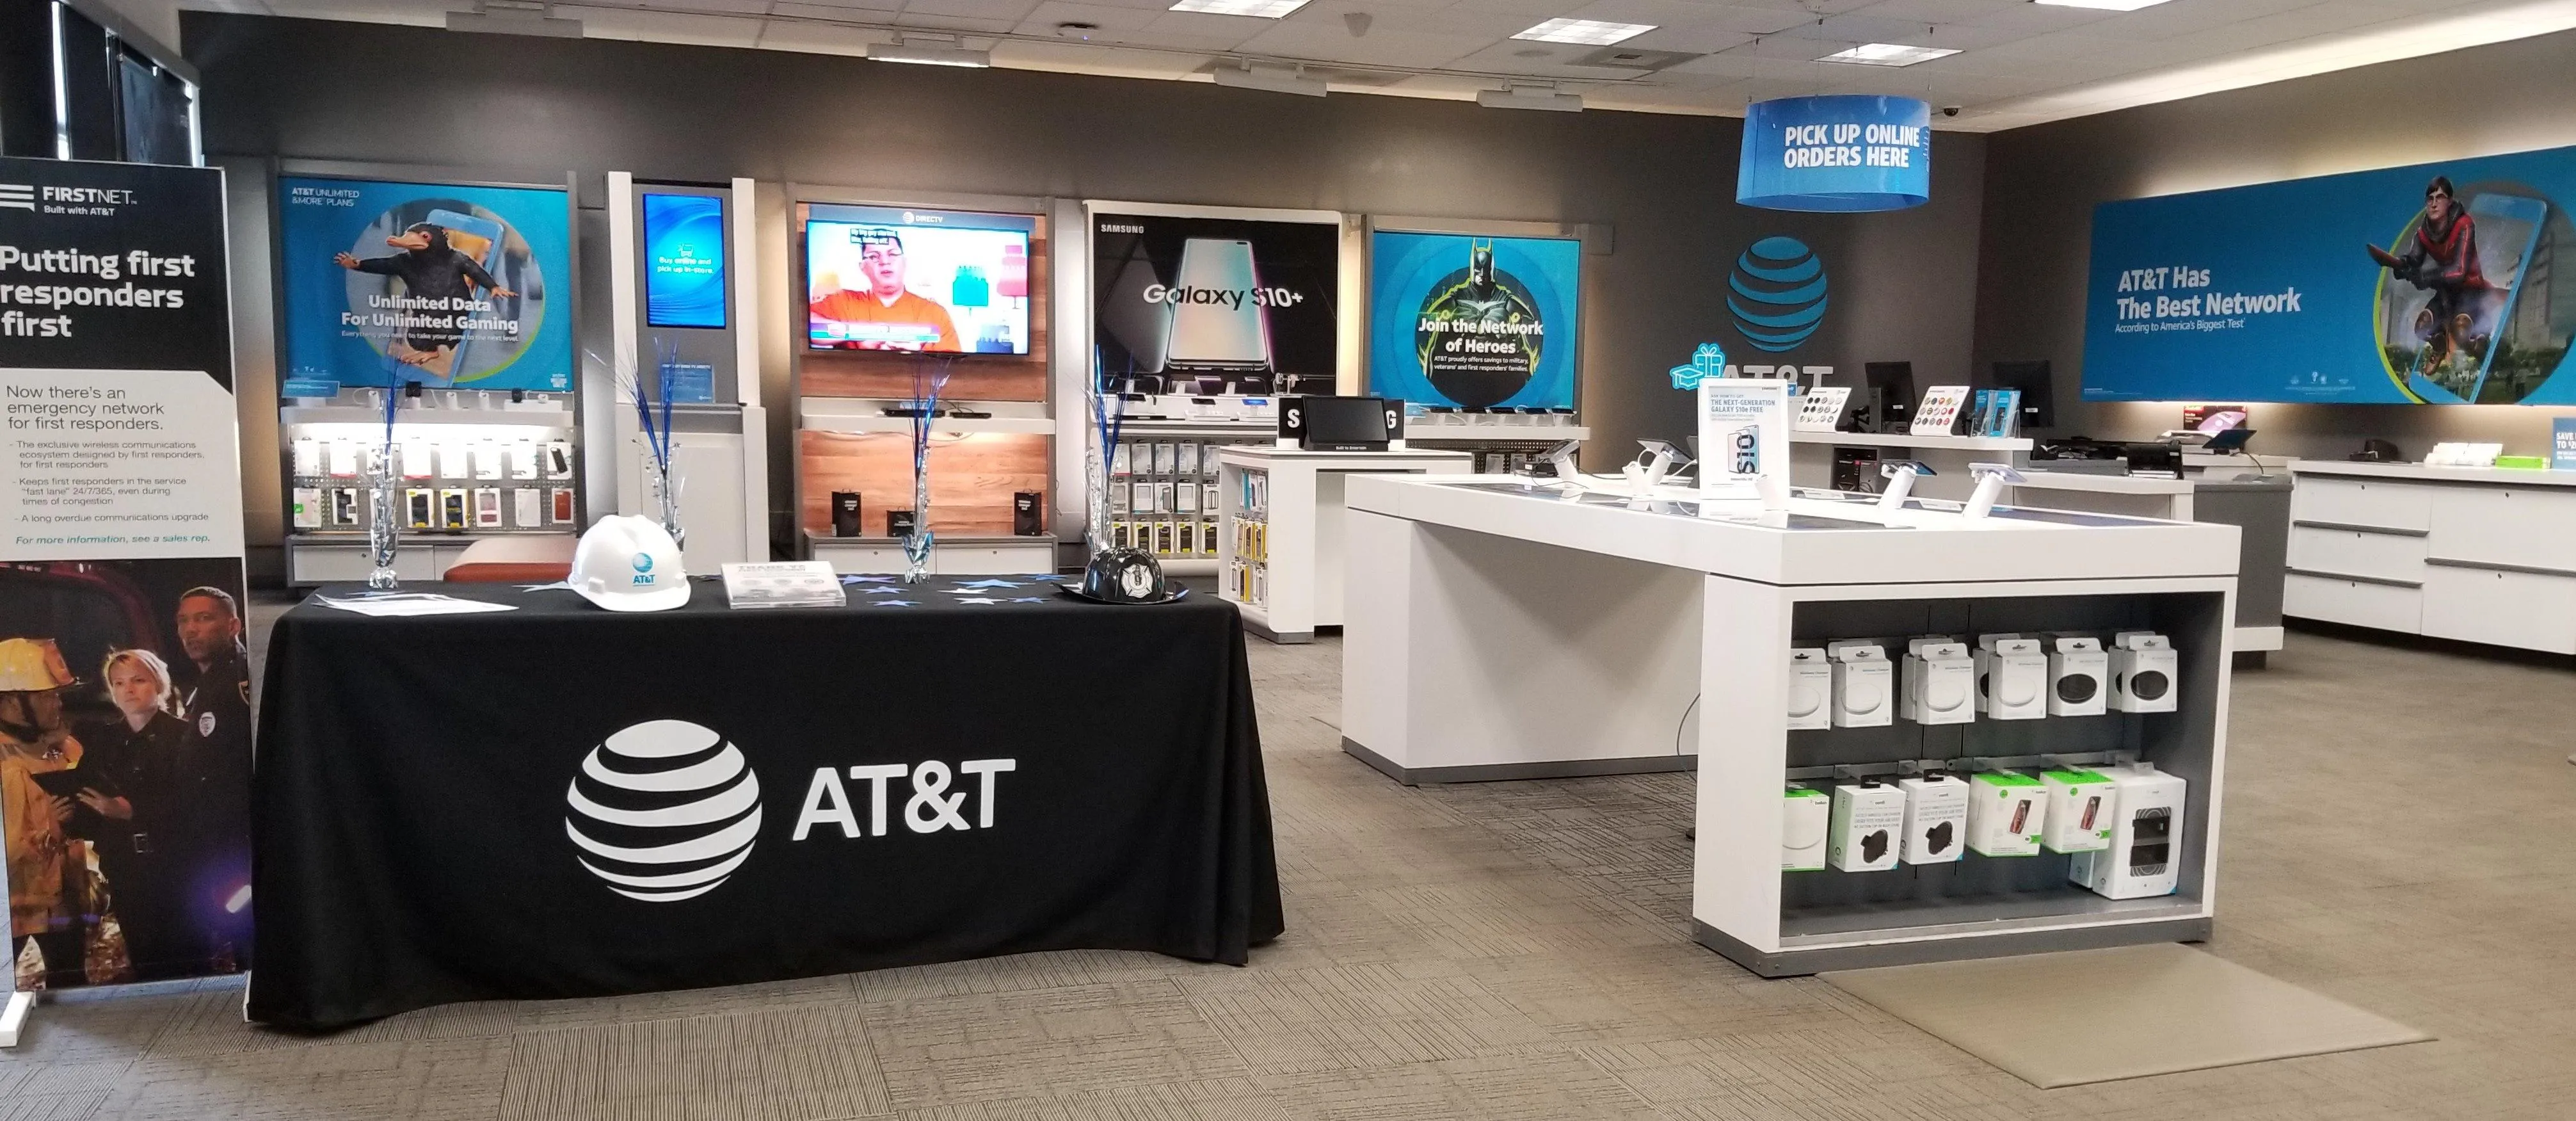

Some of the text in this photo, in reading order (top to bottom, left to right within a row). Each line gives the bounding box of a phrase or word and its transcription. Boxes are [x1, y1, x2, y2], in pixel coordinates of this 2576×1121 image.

[1785, 124, 1920, 147] PICK UP ONLINE
[1784, 147, 1862, 168] ORDERS
[1866, 147, 1909, 168] HERE
[42, 186, 133, 204] FIRSTNET
[292, 188, 360, 198] AT&T UNLIMITED
[292, 197, 355, 207] &MORE PLANS
[44, 205, 115, 216] Built with AT&T
[915, 215, 943, 223] DIRECTV
[1101, 224, 1144, 234] SAMSUNG
[0, 245, 196, 280] Putting first
[2117, 265, 2211, 293] AT&T Has
[0, 282, 184, 310] responders
[369, 294, 491, 312] Unlimited Data
[1143, 284, 1304, 311] Galaxy S10+
[2117, 286, 2302, 320] The Best Network
[1, 310, 72, 337] first
[341, 311, 519, 334] For Unlimited Gaming
[1418, 318, 1544, 335] Join the Network
[2115, 323, 2150, 334] According
[2150, 322, 2159, 332] to
[2160, 321, 2196, 331] America's
[2196, 319, 2226, 332] Biggest
[1445, 337, 1463, 353] of
[6, 385, 125, 399] Now there's an
[8, 402, 164, 417] emergency network
[8, 416, 163, 432] for first responders.
[2556, 432, 2574, 440] SAVE
[2556, 440, 2566, 449] TO
[19, 451, 70, 460] ecosystem
[73, 450, 115, 460] designed
[118, 451, 129, 460] by
[151, 451, 205, 459] responders,
[1736, 435, 1755, 472] S10
[20, 460, 33, 469] for
[56, 461, 109, 469] responders
[19, 478, 49, 487] Keeps
[72, 478, 124, 487] responders
[73, 487, 115, 496] 24/7/365,
[142, 488, 170, 496] during
[51, 497, 60, 505] of
[63, 498, 113, 506] congestion
[31, 515, 51, 523] long
[172, 513, 209, 522] upgrade
[67, 535, 128, 544] information,
[163, 535, 188, 543] sales
[191, 535, 211, 544] rep.
[633, 574, 655, 584] AT&T
[792, 758, 1016, 841] AT&T
